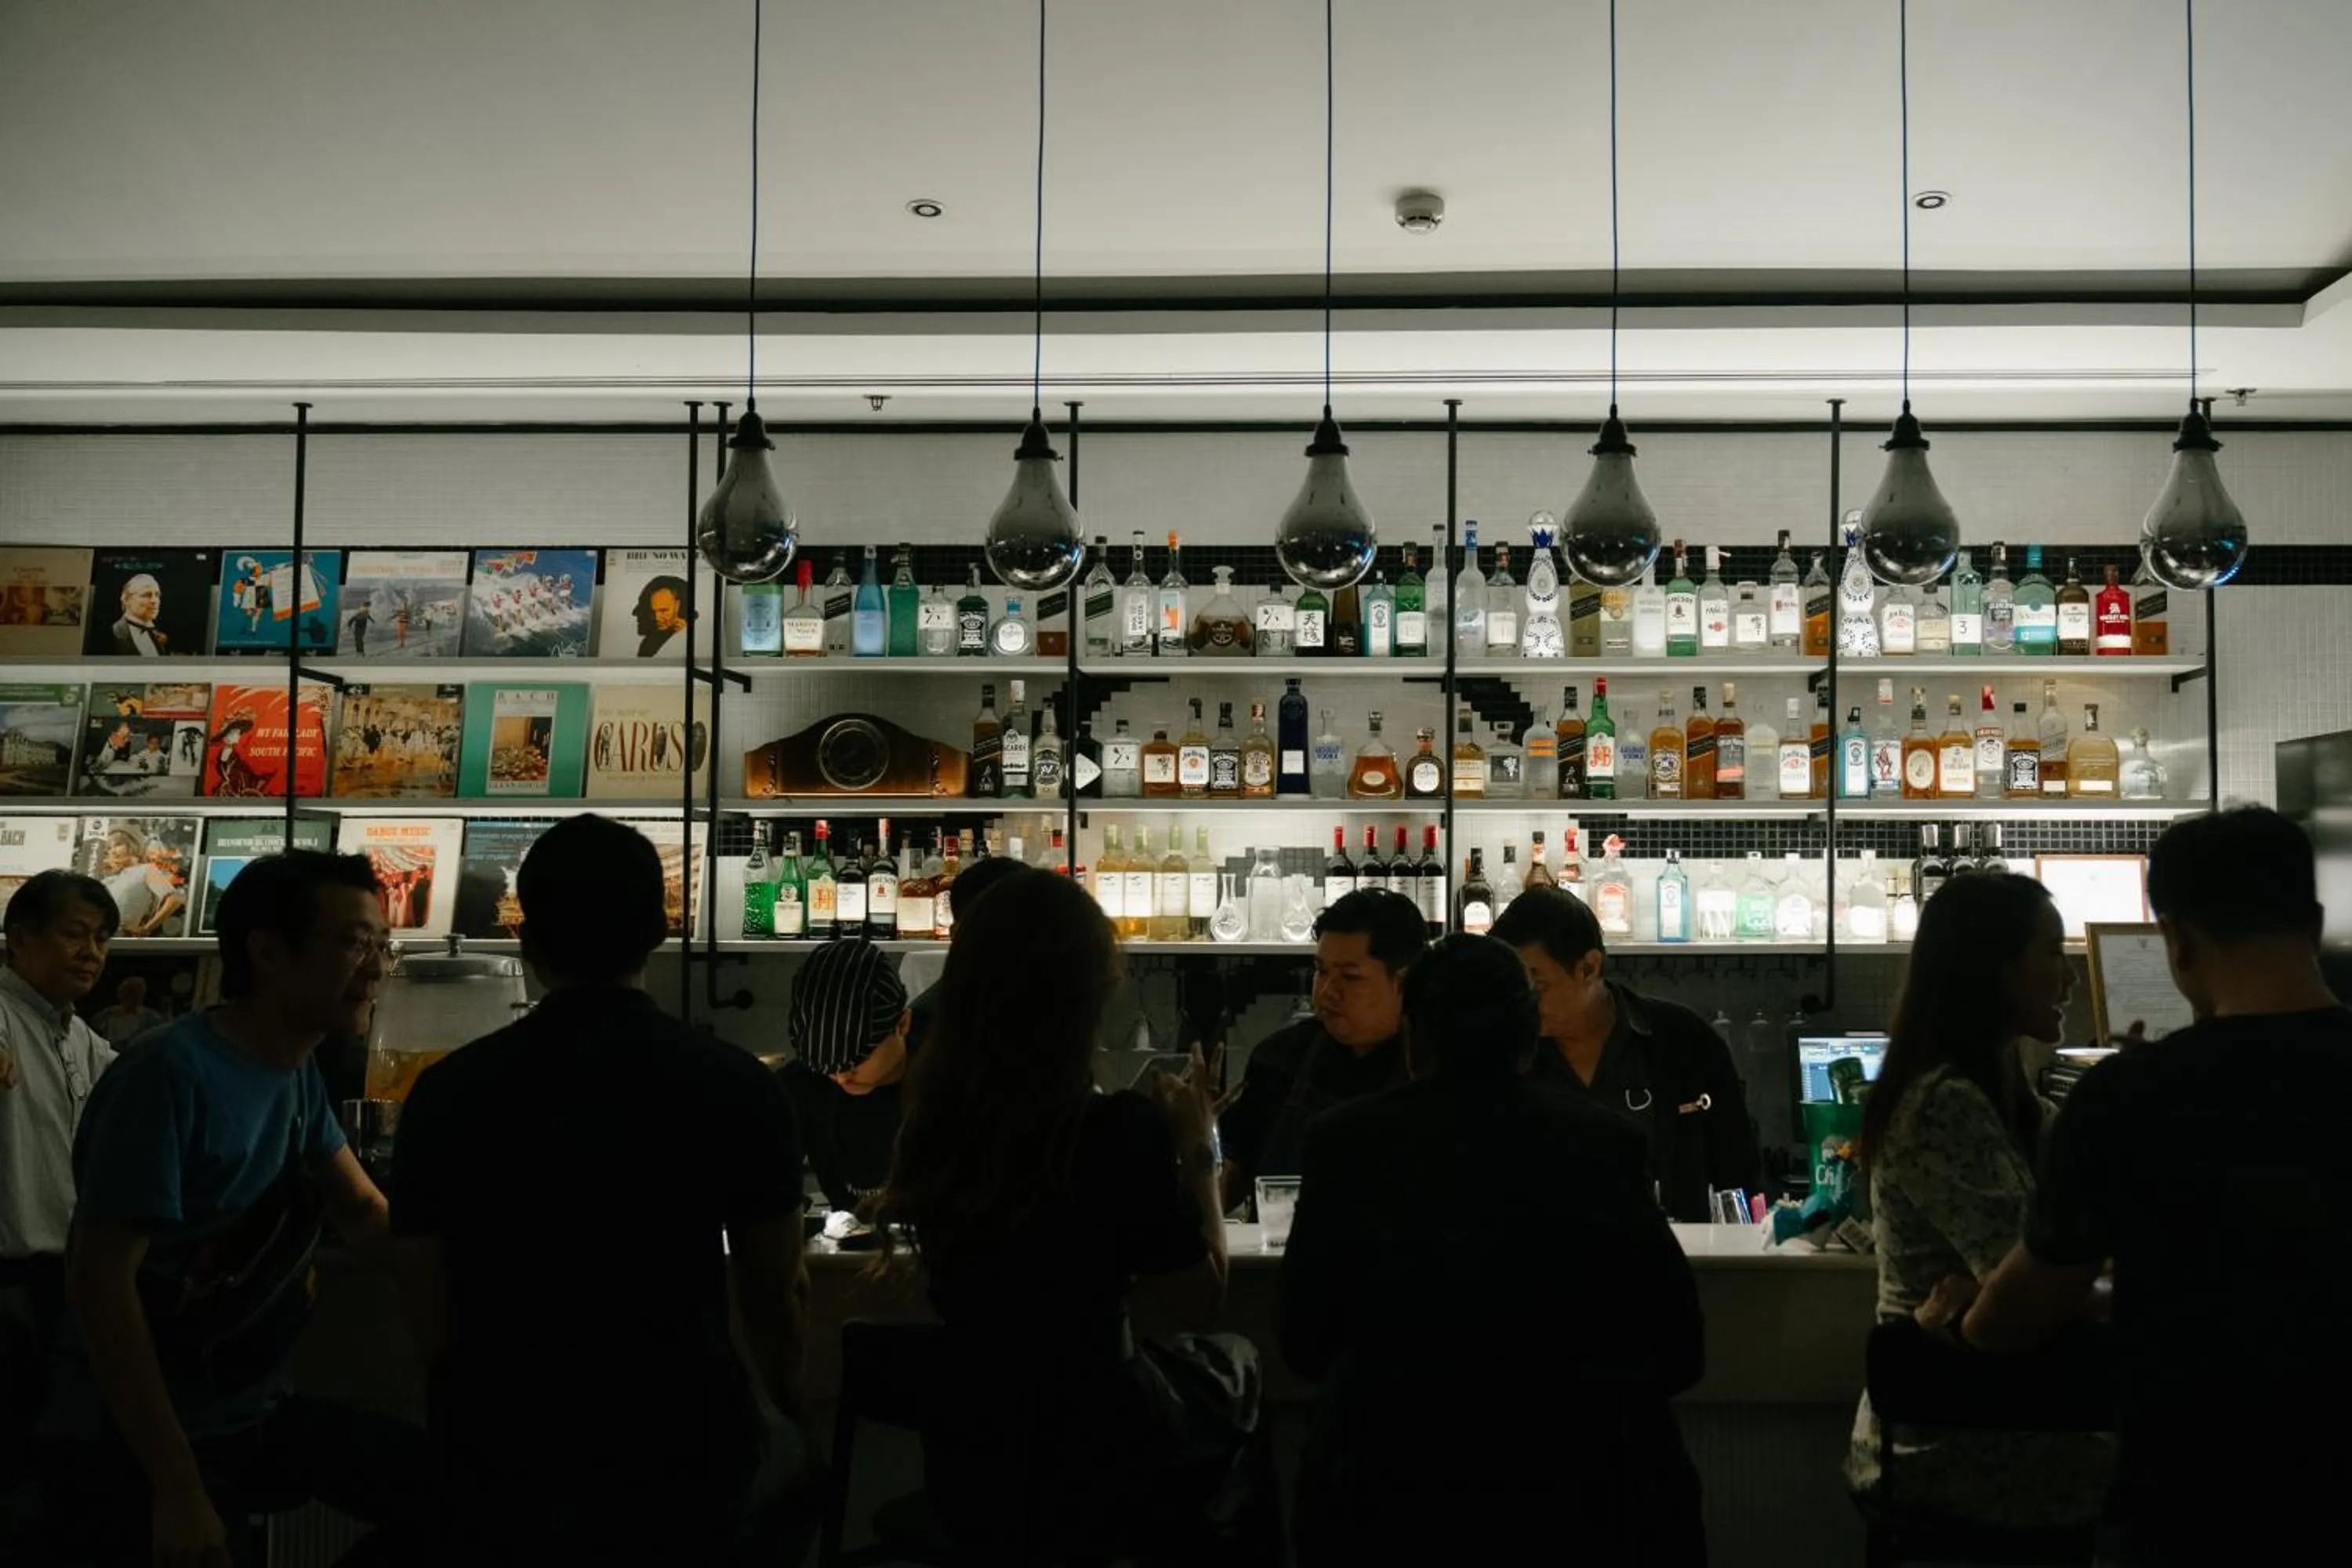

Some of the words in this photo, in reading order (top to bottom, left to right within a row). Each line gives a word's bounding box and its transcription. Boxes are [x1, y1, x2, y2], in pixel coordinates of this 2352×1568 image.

[1958, 620, 1967, 634] 3
[256, 728, 272, 738] MY
[249, 746, 281, 757] SOUTH
[593, 720, 707, 773] CARUSO
